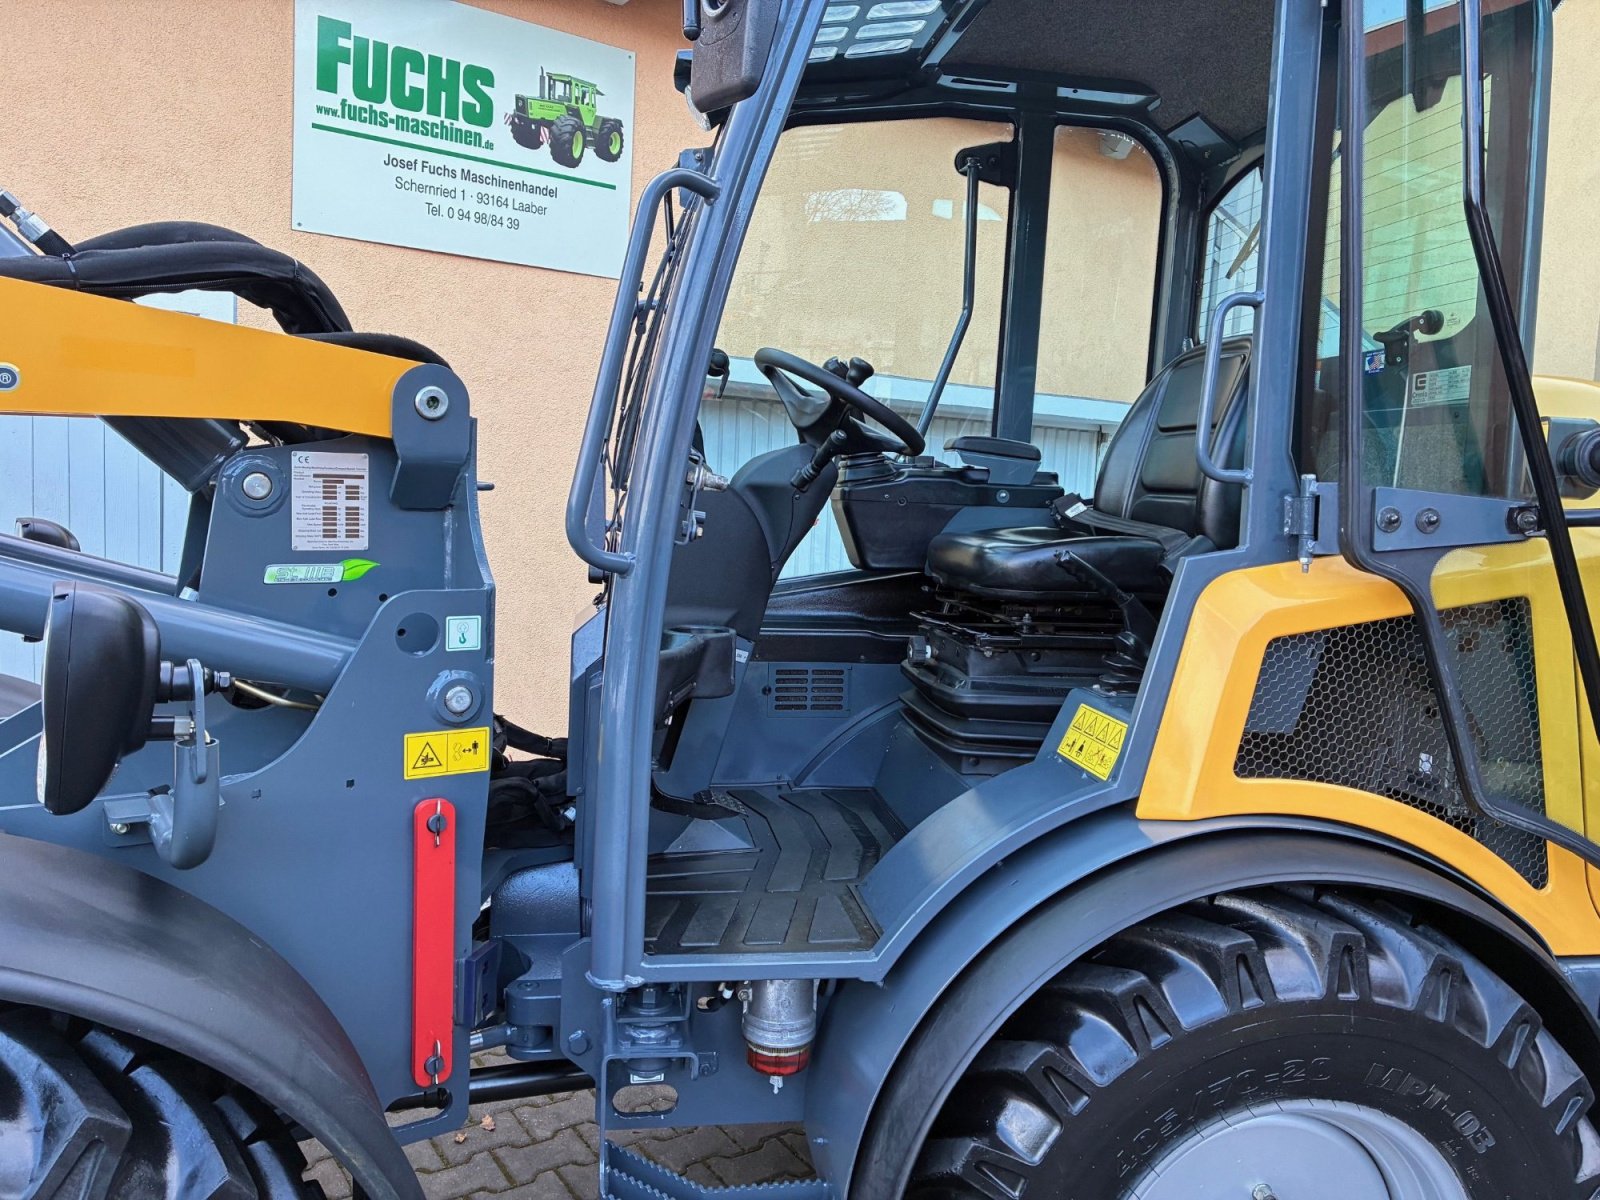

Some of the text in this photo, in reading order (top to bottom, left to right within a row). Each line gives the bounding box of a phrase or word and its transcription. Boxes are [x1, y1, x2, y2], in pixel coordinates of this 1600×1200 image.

[316, 15, 495, 128] FUCHS
[315, 98, 495, 151] www.fuchs-maschinen.de
[383, 153, 558, 199] Josef Fuchs Maschinenhandel
[394, 175, 457, 200] Schernried
[460, 189, 466, 201] 1
[476, 191, 509, 209] 93164
[512, 198, 548, 216] Laaber
[425, 202, 520, 231] Tel. 0 94 98/84 39
[298, 455, 310, 464] CE
[1361, 1062, 1497, 1154] MPT-03
